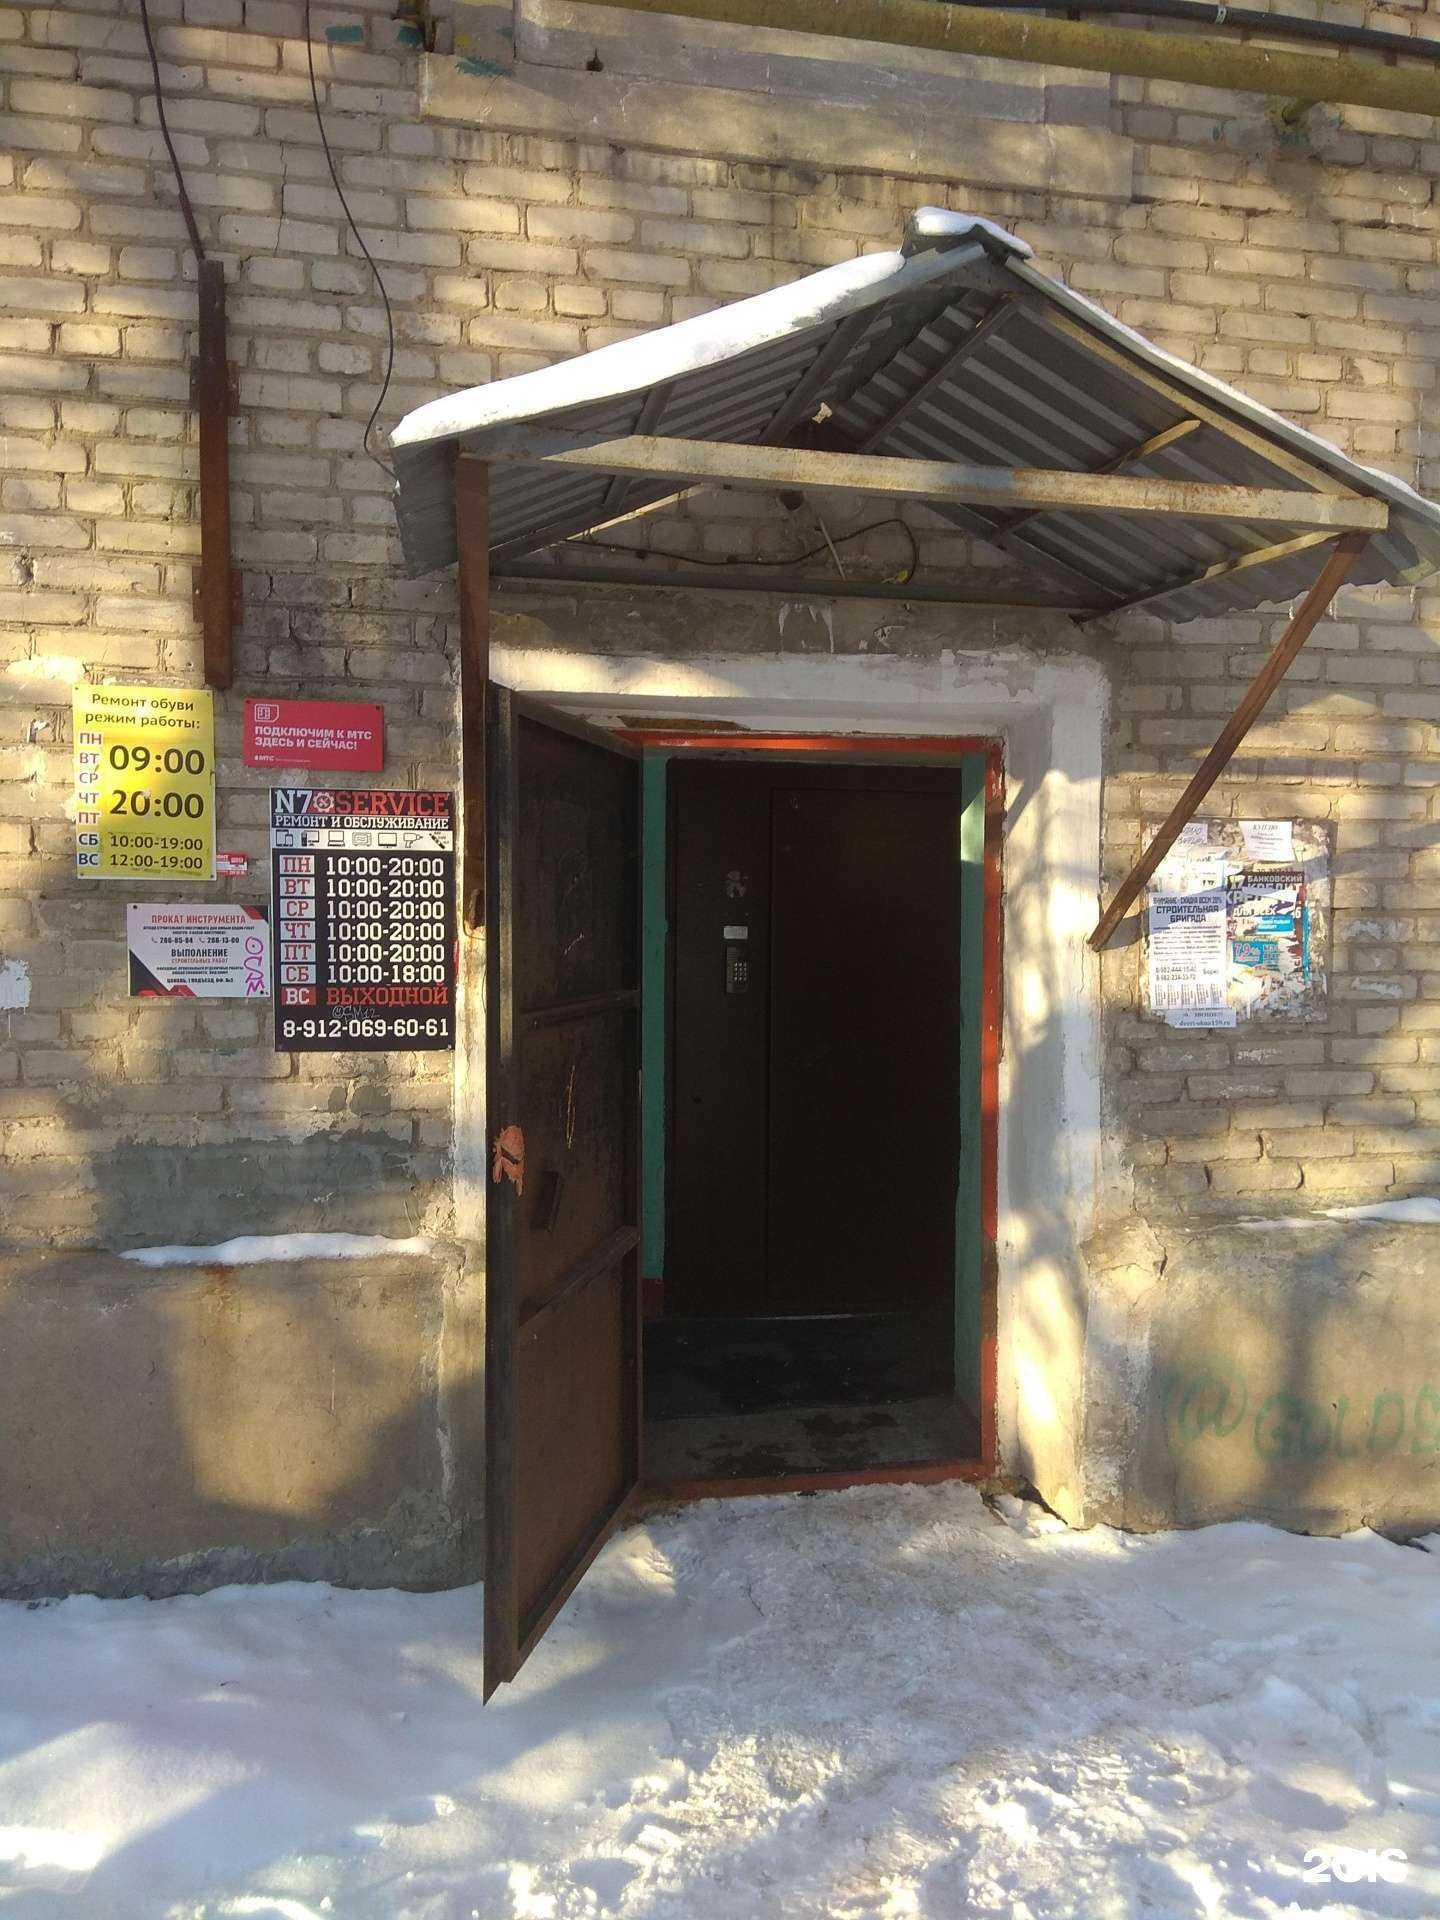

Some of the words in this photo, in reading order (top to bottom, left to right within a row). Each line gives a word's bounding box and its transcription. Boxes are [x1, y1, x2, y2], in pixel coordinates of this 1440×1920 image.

[92, 693, 146, 708] Ремонт
[151, 698, 194, 714] обуви
[85, 713, 136, 724] режим
[141, 717, 200, 729] работы:
[80, 732, 102, 745] ПН
[254, 726, 334, 738] ПОДКЛЮЧИМ
[336, 730, 344, 738] К
[347, 730, 372, 740] МТС
[254, 737, 294, 748] ЗДЕСЬ
[296, 738, 304, 747] И
[307, 739, 358, 750] СЕЙЧАС!
[79, 752, 100, 764] ВТ
[109, 744, 206, 775] 09:00
[79, 772, 98, 784] СР
[78, 792, 99, 804] ЧТ
[109, 789, 204, 819] 20:00
[275, 790, 313, 814] N7
[336, 792, 449, 816] SERVICE
[78, 812, 100, 824] ПТ
[275, 816, 328, 828] РЕМОНТ
[330, 816, 342, 828] И
[344, 816, 449, 829] ОБСЛУЖИВАНИЕ
[78, 833, 98, 846] СБ
[111, 835, 203, 851] 10:00-19:00
[78, 853, 98, 866] ВС
[110, 854, 203, 869] 12:00-19:00
[283, 858, 311, 873] ПН
[326, 857, 444, 877] 10:00-20:00
[1247, 874, 1302, 883] БАНКОВСКИЙ
[284, 879, 310, 894] ВТ
[326, 878, 444, 898] 10:00-20:00
[286, 901, 310, 916] СР
[326, 900, 444, 920] 10:00-20:00
[1156, 905, 1219, 914] СТРОИТЕЛЬНАЯ
[152, 914, 183, 924] ПРОКАТ
[186, 915, 246, 924] ИНСТРУМЕНТА
[1170, 914, 1206, 923] БРИГАДА
[284, 923, 310, 938] ЧТ
[327, 922, 444, 941] 10:00-20:00
[171, 948, 228, 958] ВЫПОЛНЕНИЕ
[284, 945, 311, 960] ПТ
[327, 944, 444, 963] 10:00-20:00
[286, 966, 310, 982] СБ
[328, 964, 444, 984] 10:00-18:00
[285, 988, 310, 1004] ВС
[326, 983, 449, 1007] ВЫХОДНОЙ
[283, 1018, 449, 1038] 8-912-069-60-61
